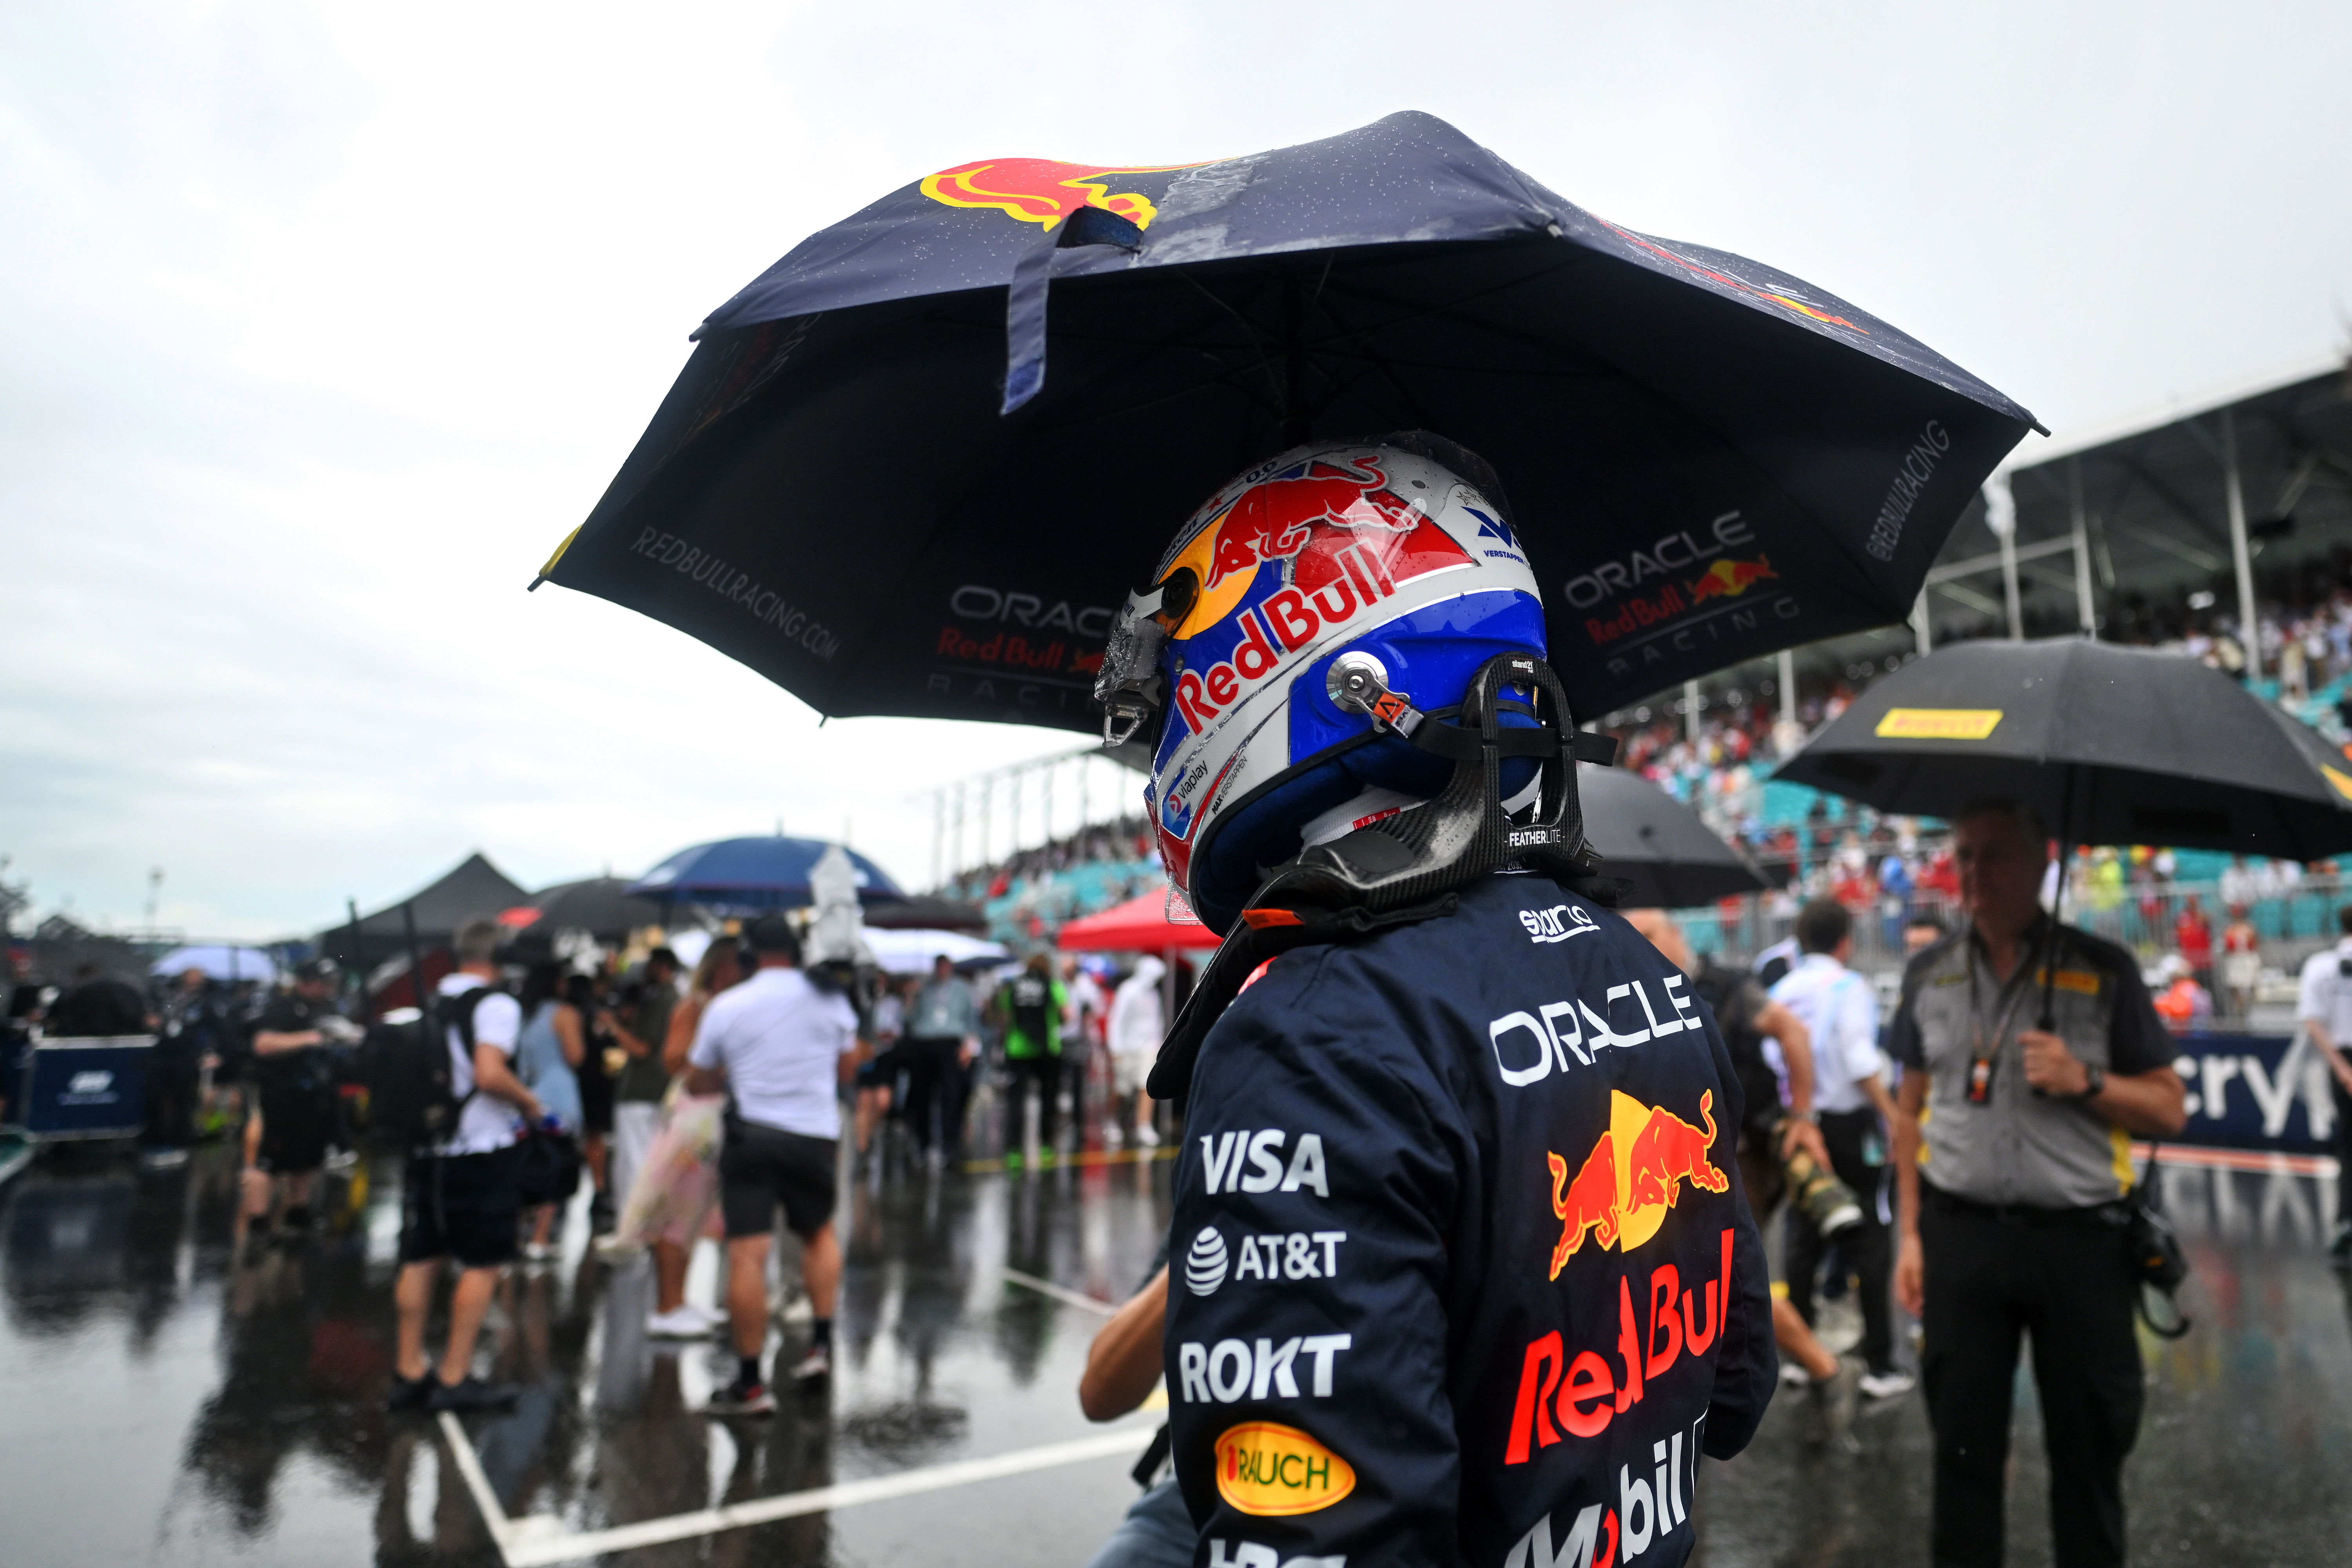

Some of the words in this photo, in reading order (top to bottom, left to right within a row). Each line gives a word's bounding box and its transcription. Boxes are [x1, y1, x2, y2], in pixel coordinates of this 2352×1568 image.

[1564, 510, 1755, 609] ORACLE
[630, 526, 842, 662] REDBULLRACING.COM
[951, 584, 1120, 638] ORAC
[1584, 603, 1635, 644] Red
[1631, 583, 1686, 628] Bull
[937, 627, 1004, 661] Red
[1004, 634, 1066, 670] Bull
[1176, 613, 1279, 735] Red
[1263, 543, 1396, 648] Bull
[1512, 660, 1533, 669] stand21
[1606, 596, 1801, 675] RACING
[1178, 760, 1208, 799] viaplay
[1509, 830, 1561, 847] FEATHERLITE
[1519, 904, 1593, 943] sparco
[1490, 974, 1702, 1087] ORACLE
[1199, 1129, 1329, 1198] VISA
[1235, 1231, 1346, 1281] AT&T
[1179, 1333, 1352, 1403] ROKT
[1504, 1274, 1644, 1465] Red
[1645, 1228, 1734, 1381] Bul
[1239, 1448, 1329, 1491] RAUCH
